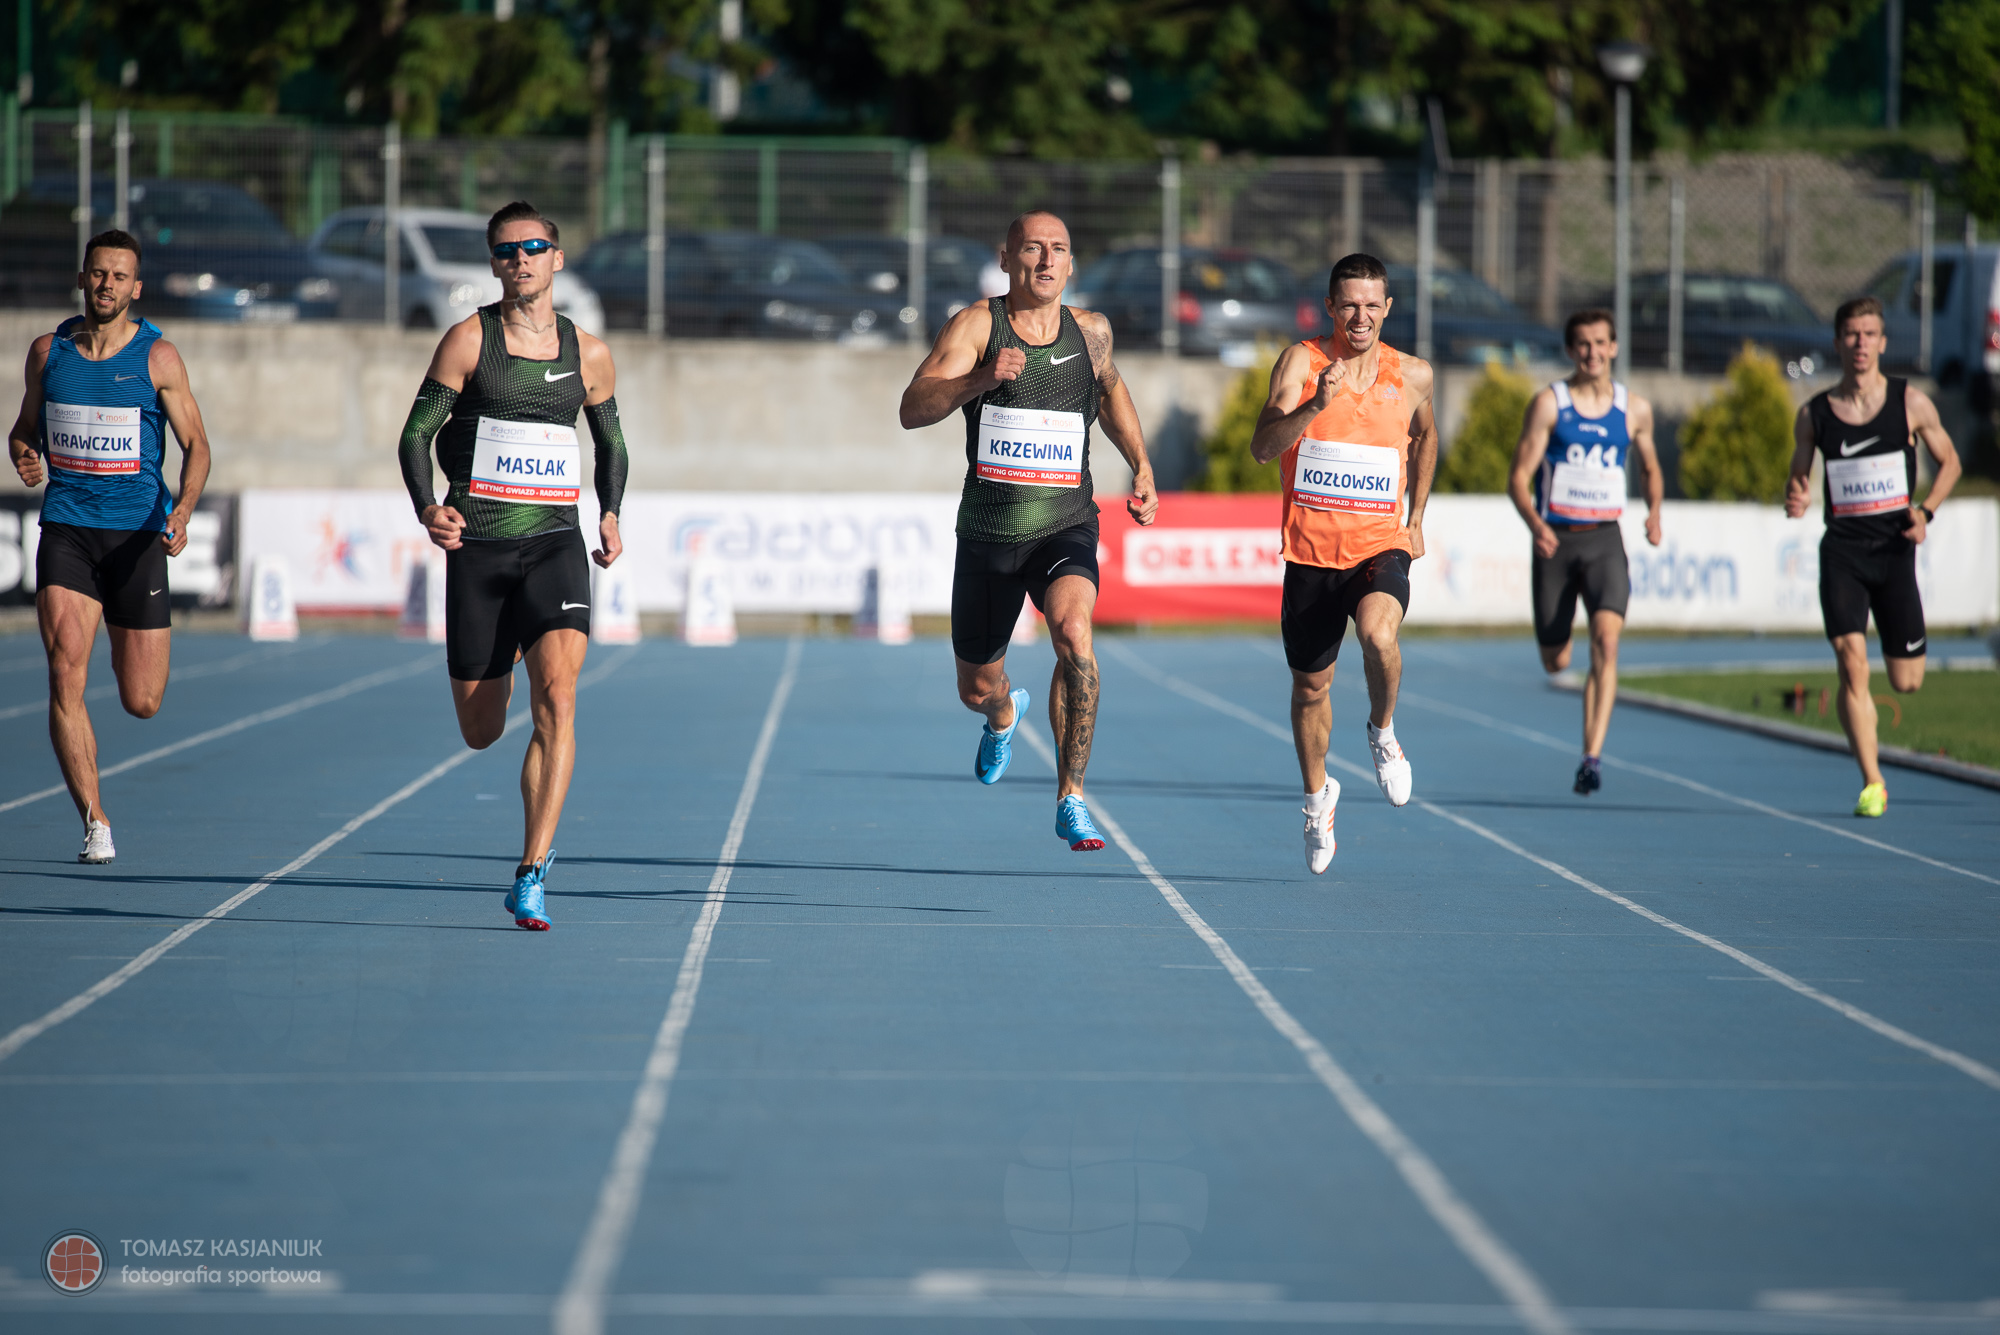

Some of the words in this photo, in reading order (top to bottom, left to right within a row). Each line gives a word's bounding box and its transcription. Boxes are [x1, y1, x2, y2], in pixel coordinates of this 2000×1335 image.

[106, 414, 128, 422] mosir
[52, 431, 133, 452] KRAWCZUK
[990, 438, 1072, 460] KRZEWINA
[496, 456, 566, 476] MASLAK
[982, 466, 1006, 476] MITYNG
[1008, 470, 1036, 478] GWIAZD
[1041, 472, 1064, 480] RADOM
[1303, 468, 1390, 492] KOZŁOWSKI
[476, 482, 504, 493] MITYNG
[505, 487, 535, 496] GWIAZD
[564, 490, 575, 498] 2018
[1298, 494, 1322, 503] MITYNG
[1323, 498, 1350, 506] GWIAZD
[1354, 501, 1377, 509] RADOM
[1378, 502, 1391, 510] 2018
